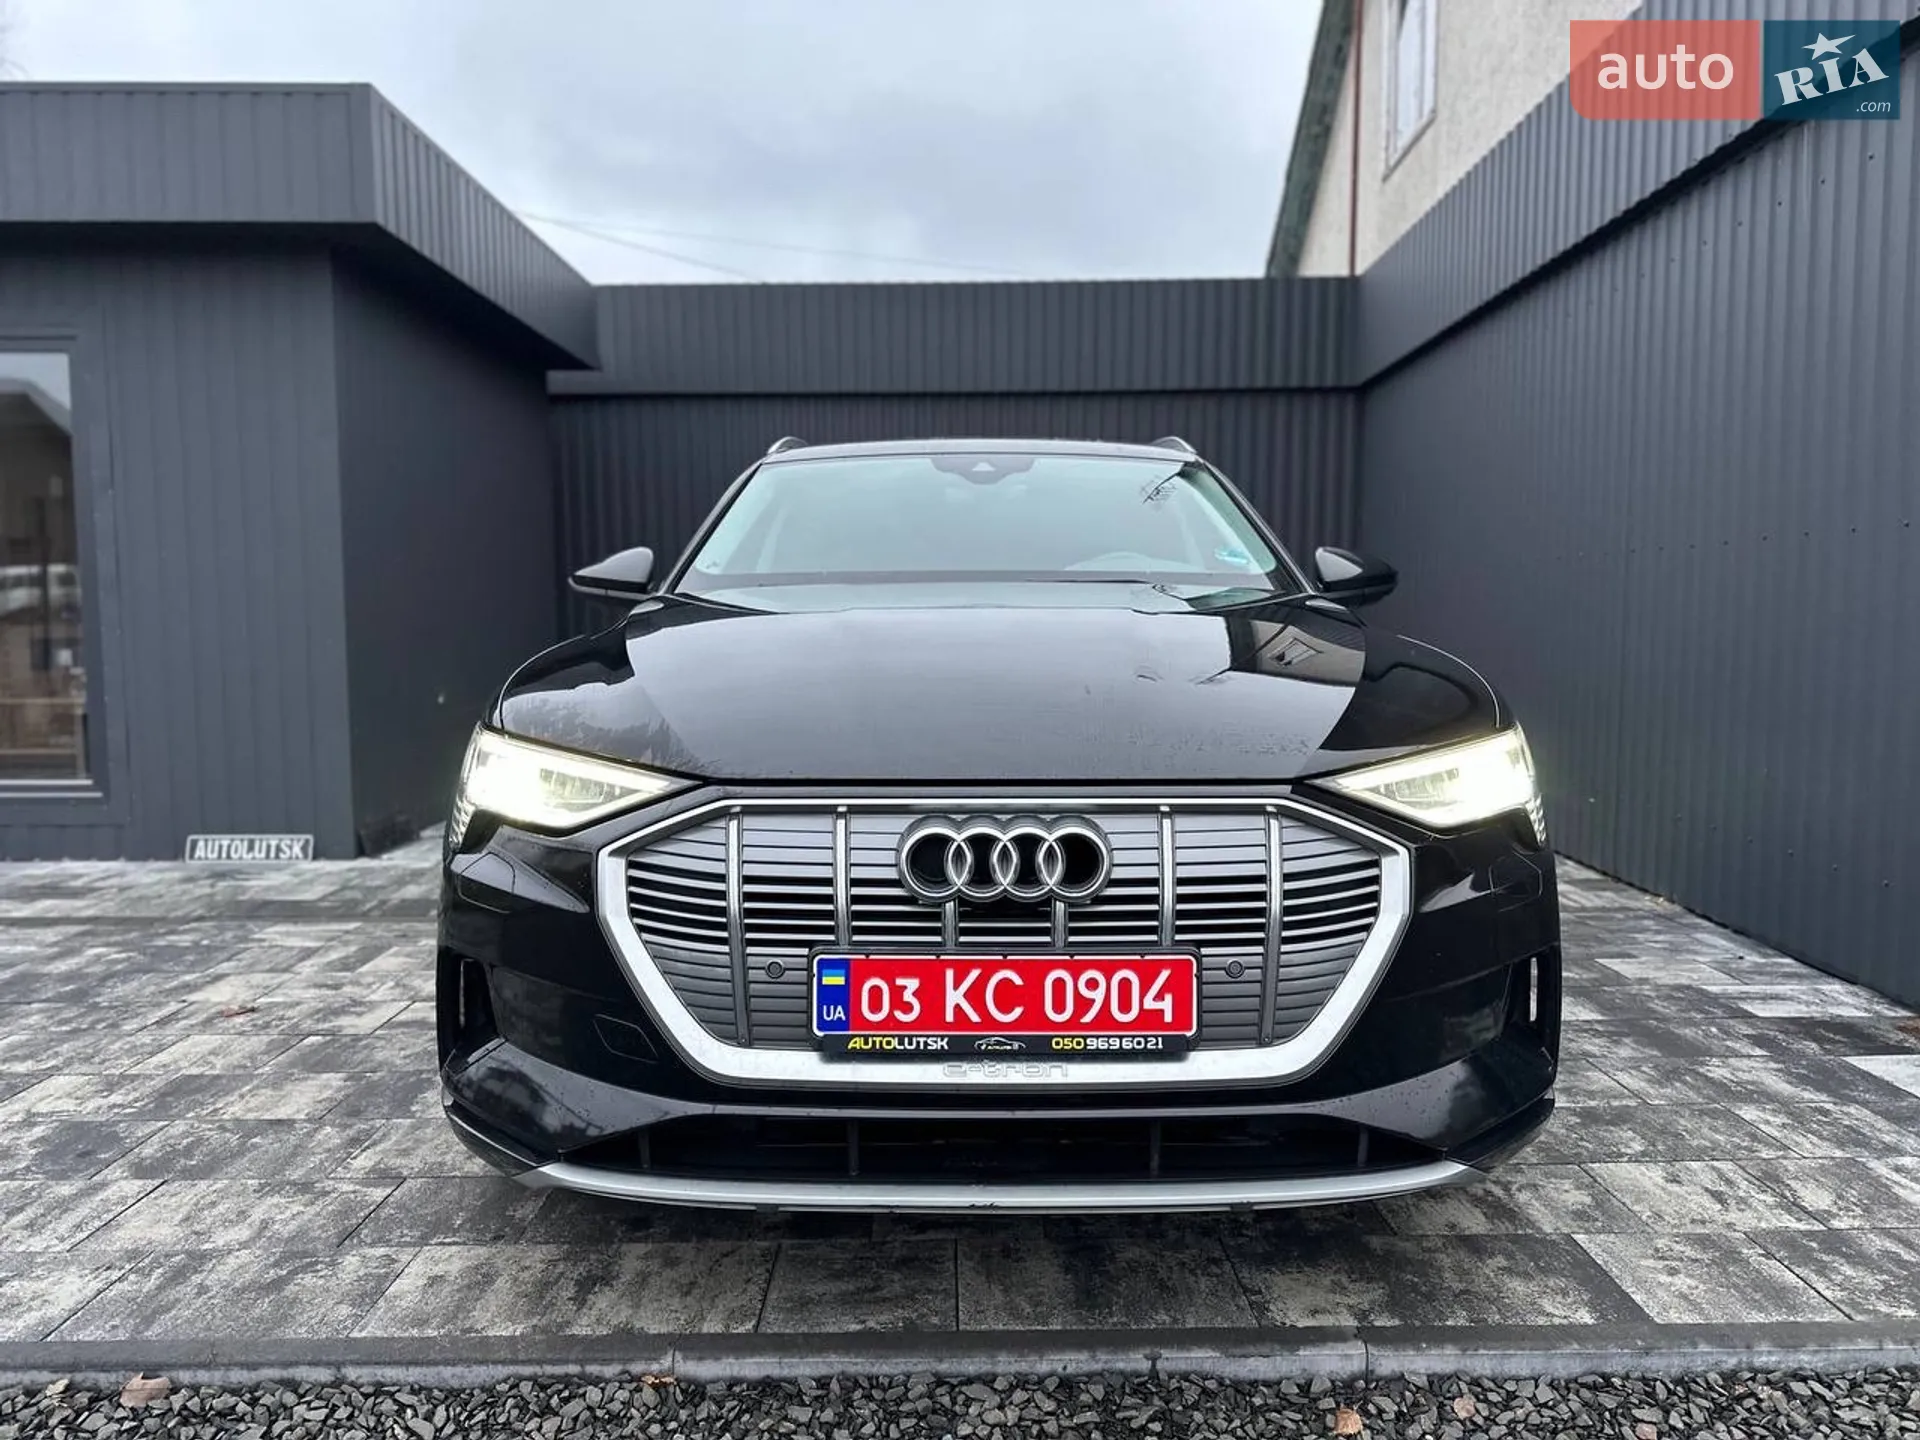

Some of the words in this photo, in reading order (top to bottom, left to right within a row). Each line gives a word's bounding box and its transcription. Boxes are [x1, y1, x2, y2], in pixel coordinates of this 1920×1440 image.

[194, 839, 305, 859] AUTOLUTSK
[861, 977, 921, 1023] 03
[944, 967, 1025, 1023] KC
[1043, 968, 1174, 1023] 0904
[822, 1005, 846, 1021] UA
[847, 1036, 949, 1050] AUTOLUTSK
[942, 1060, 1068, 1078] e-tron
